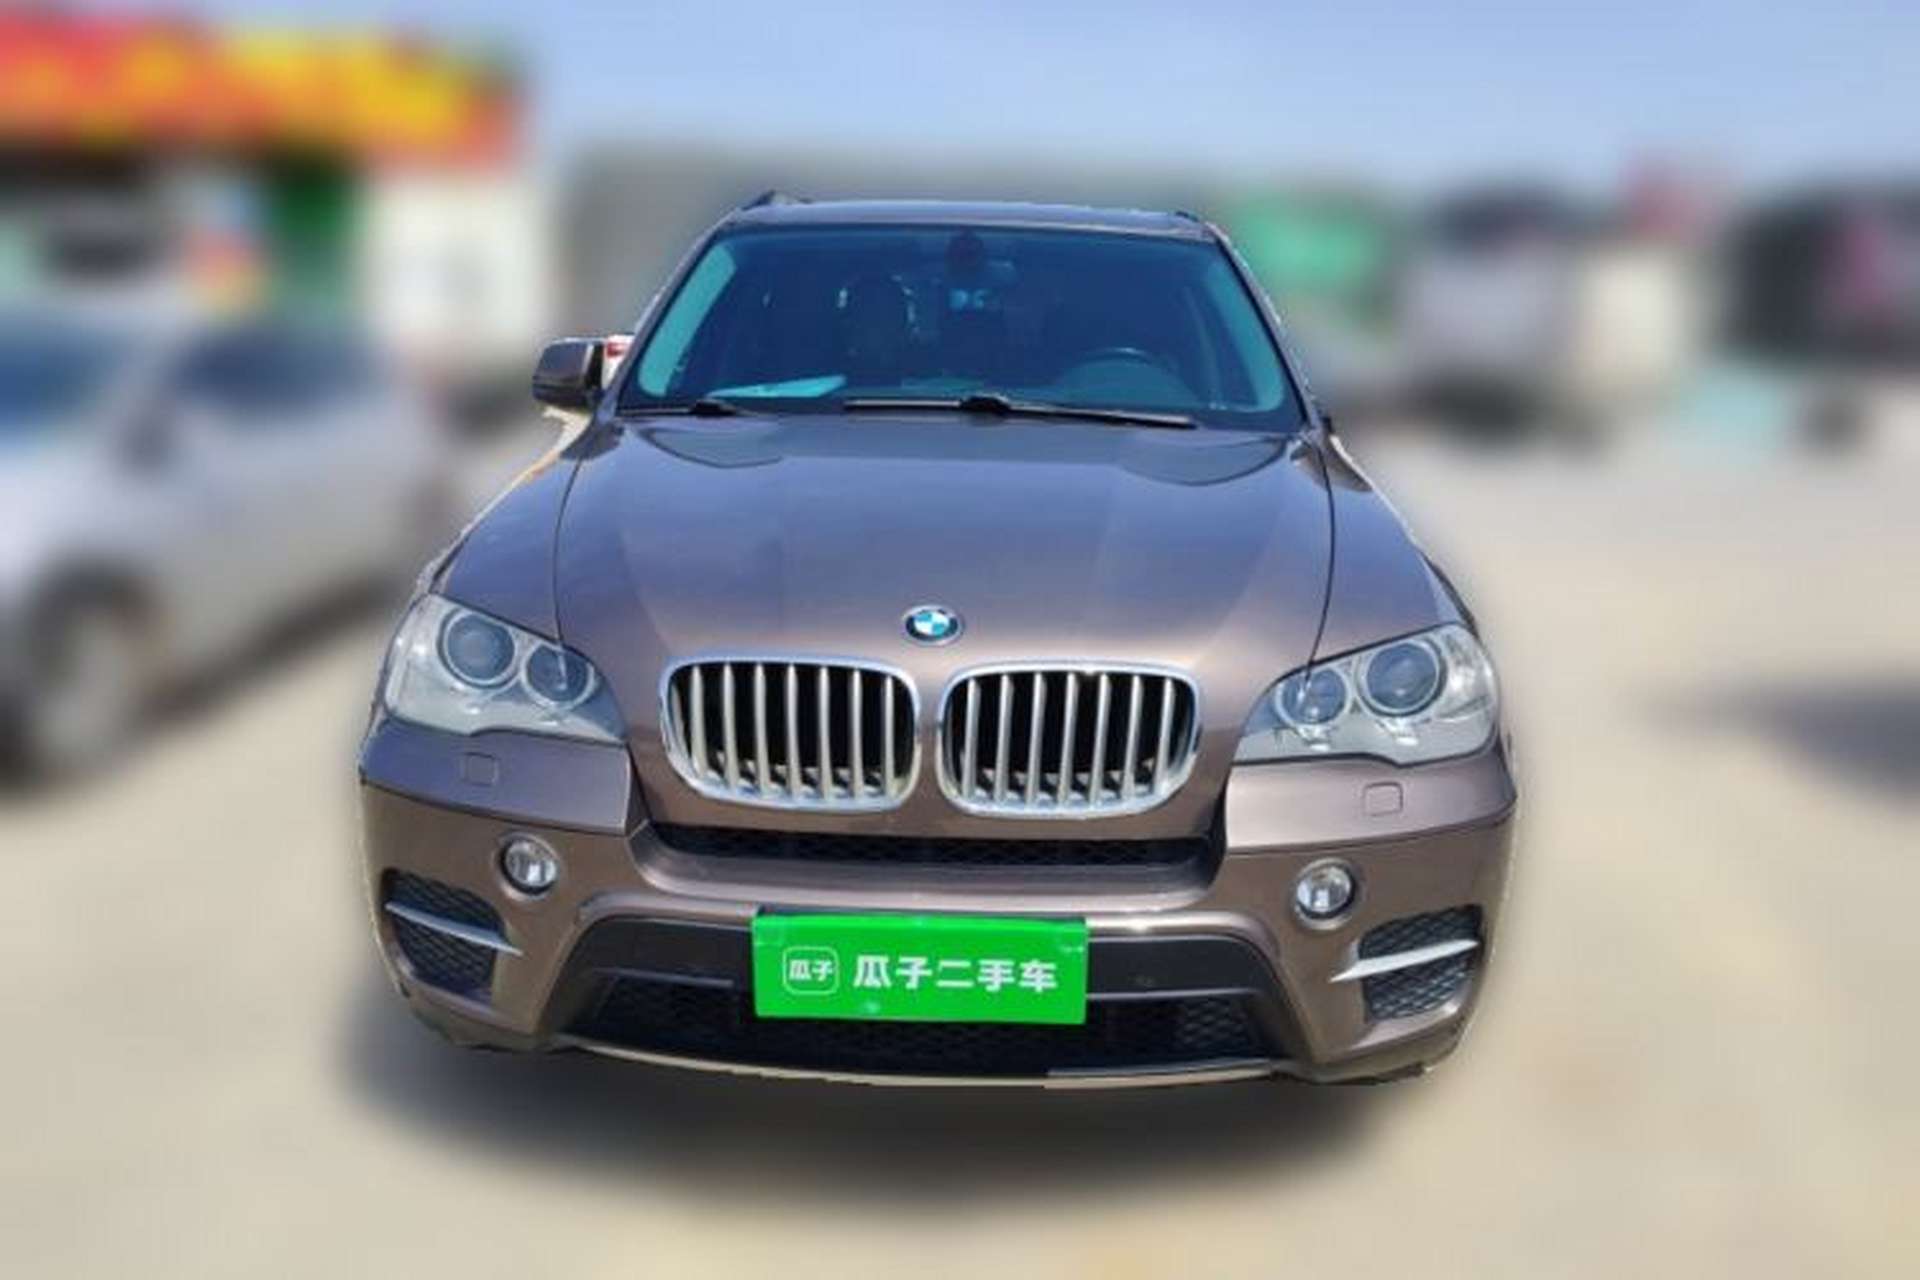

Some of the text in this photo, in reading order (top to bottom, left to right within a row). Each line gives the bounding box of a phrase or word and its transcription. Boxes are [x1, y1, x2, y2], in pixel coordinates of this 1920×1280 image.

[789, 958, 833, 981] 瓜子
[853, 954, 1058, 993] 瓜子二手车
